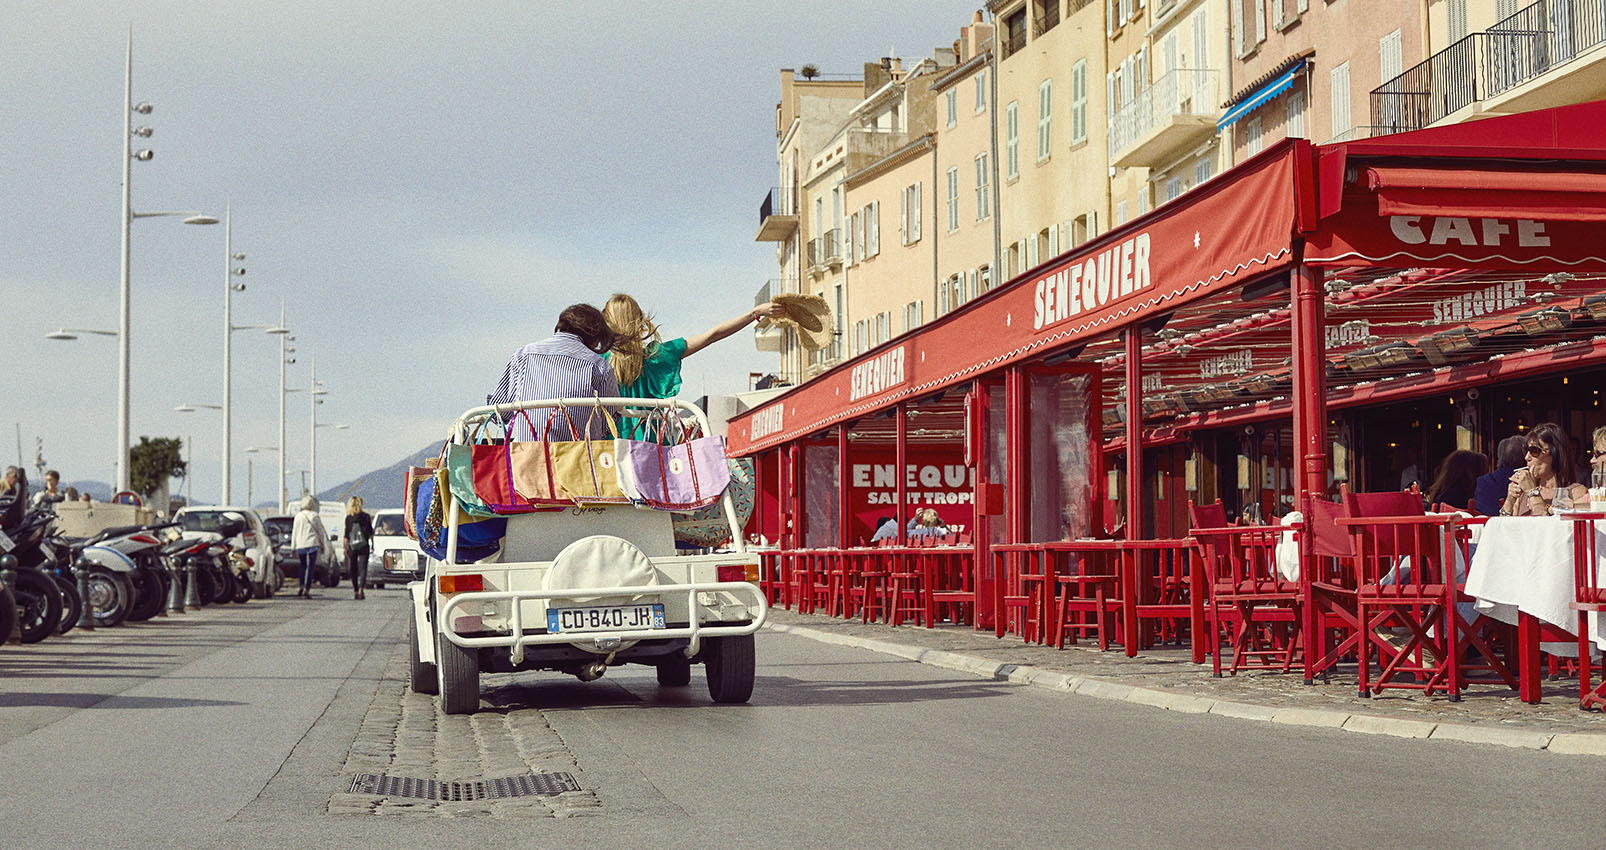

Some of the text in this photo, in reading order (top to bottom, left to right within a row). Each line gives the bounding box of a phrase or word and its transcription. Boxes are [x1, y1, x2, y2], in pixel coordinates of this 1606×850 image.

[1390, 216, 1551, 247] CAFE
[1033, 231, 1152, 330] SENEQUIER
[850, 346, 905, 402] SENEQUIER
[923, 491, 975, 505] TROP
[562, 607, 651, 629] CD-840-JH
[654, 616, 664, 627] 83
